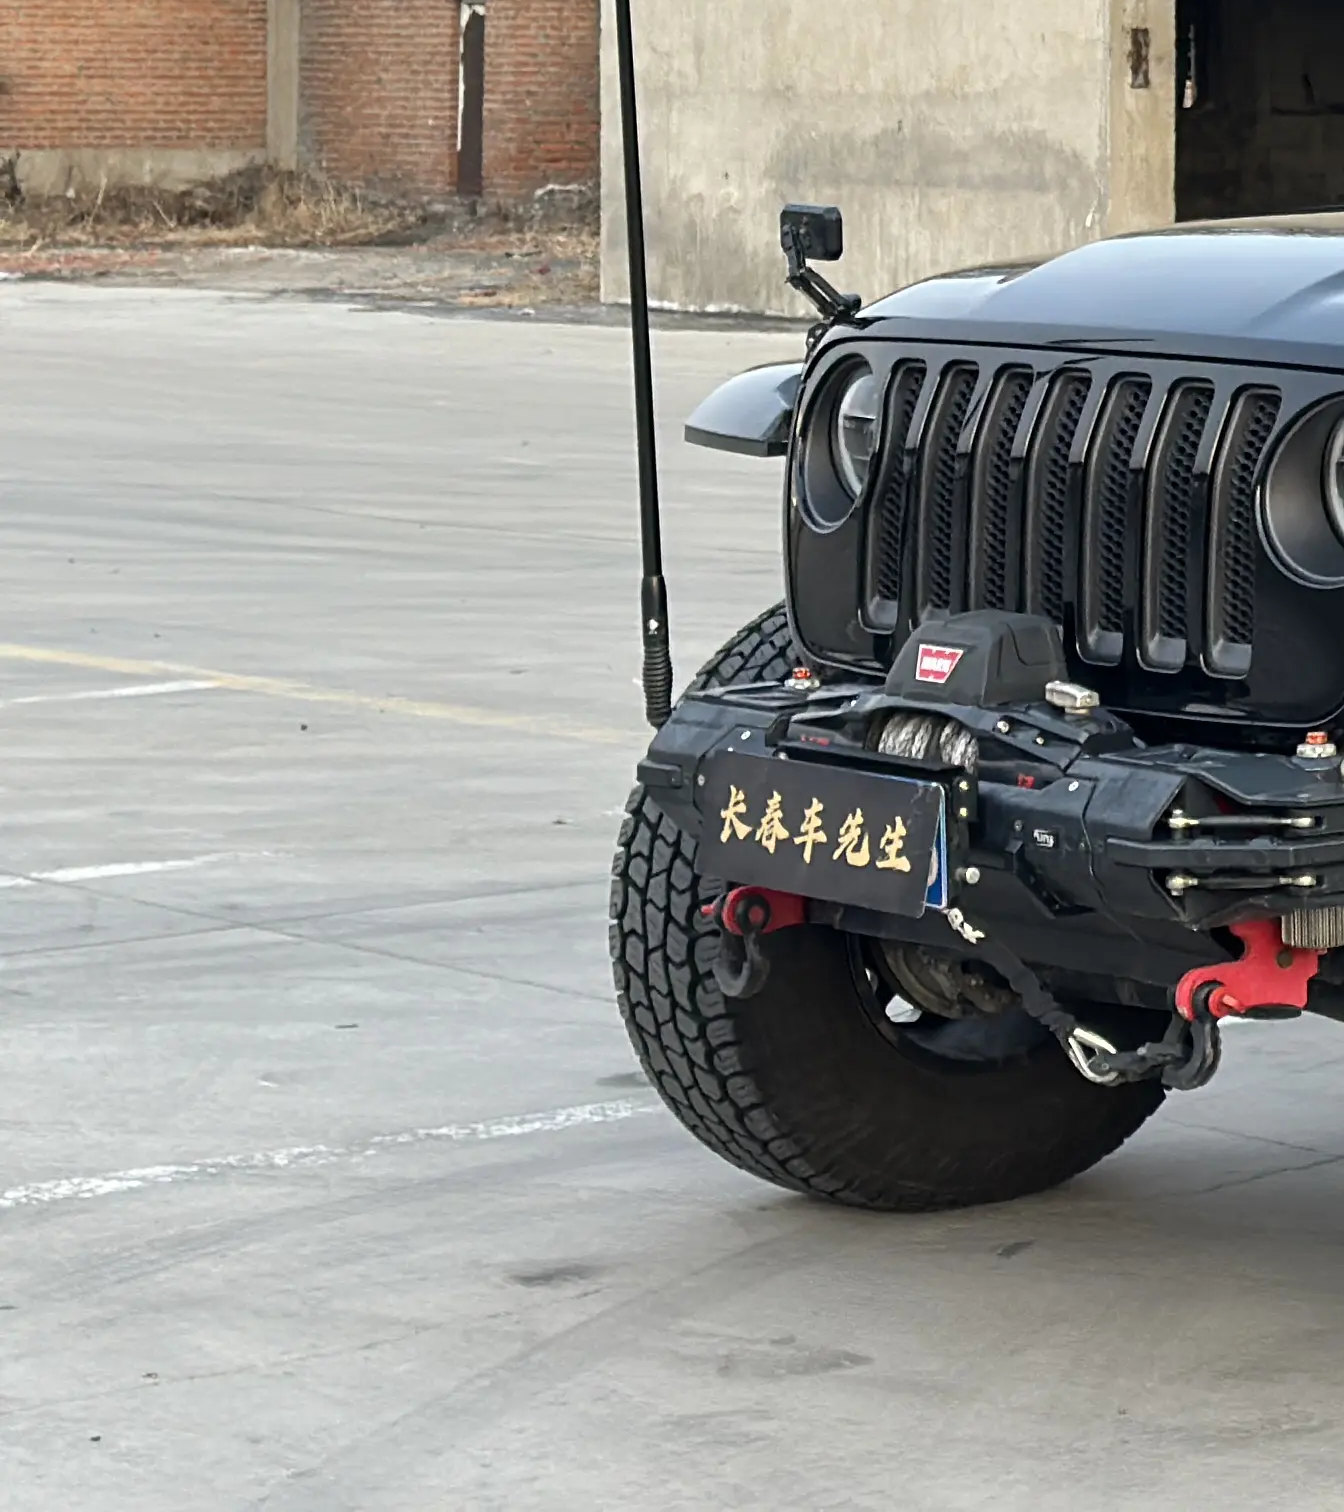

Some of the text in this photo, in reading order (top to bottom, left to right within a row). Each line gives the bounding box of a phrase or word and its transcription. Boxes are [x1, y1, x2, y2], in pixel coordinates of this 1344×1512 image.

[719, 784, 911, 873] 长春车先生
